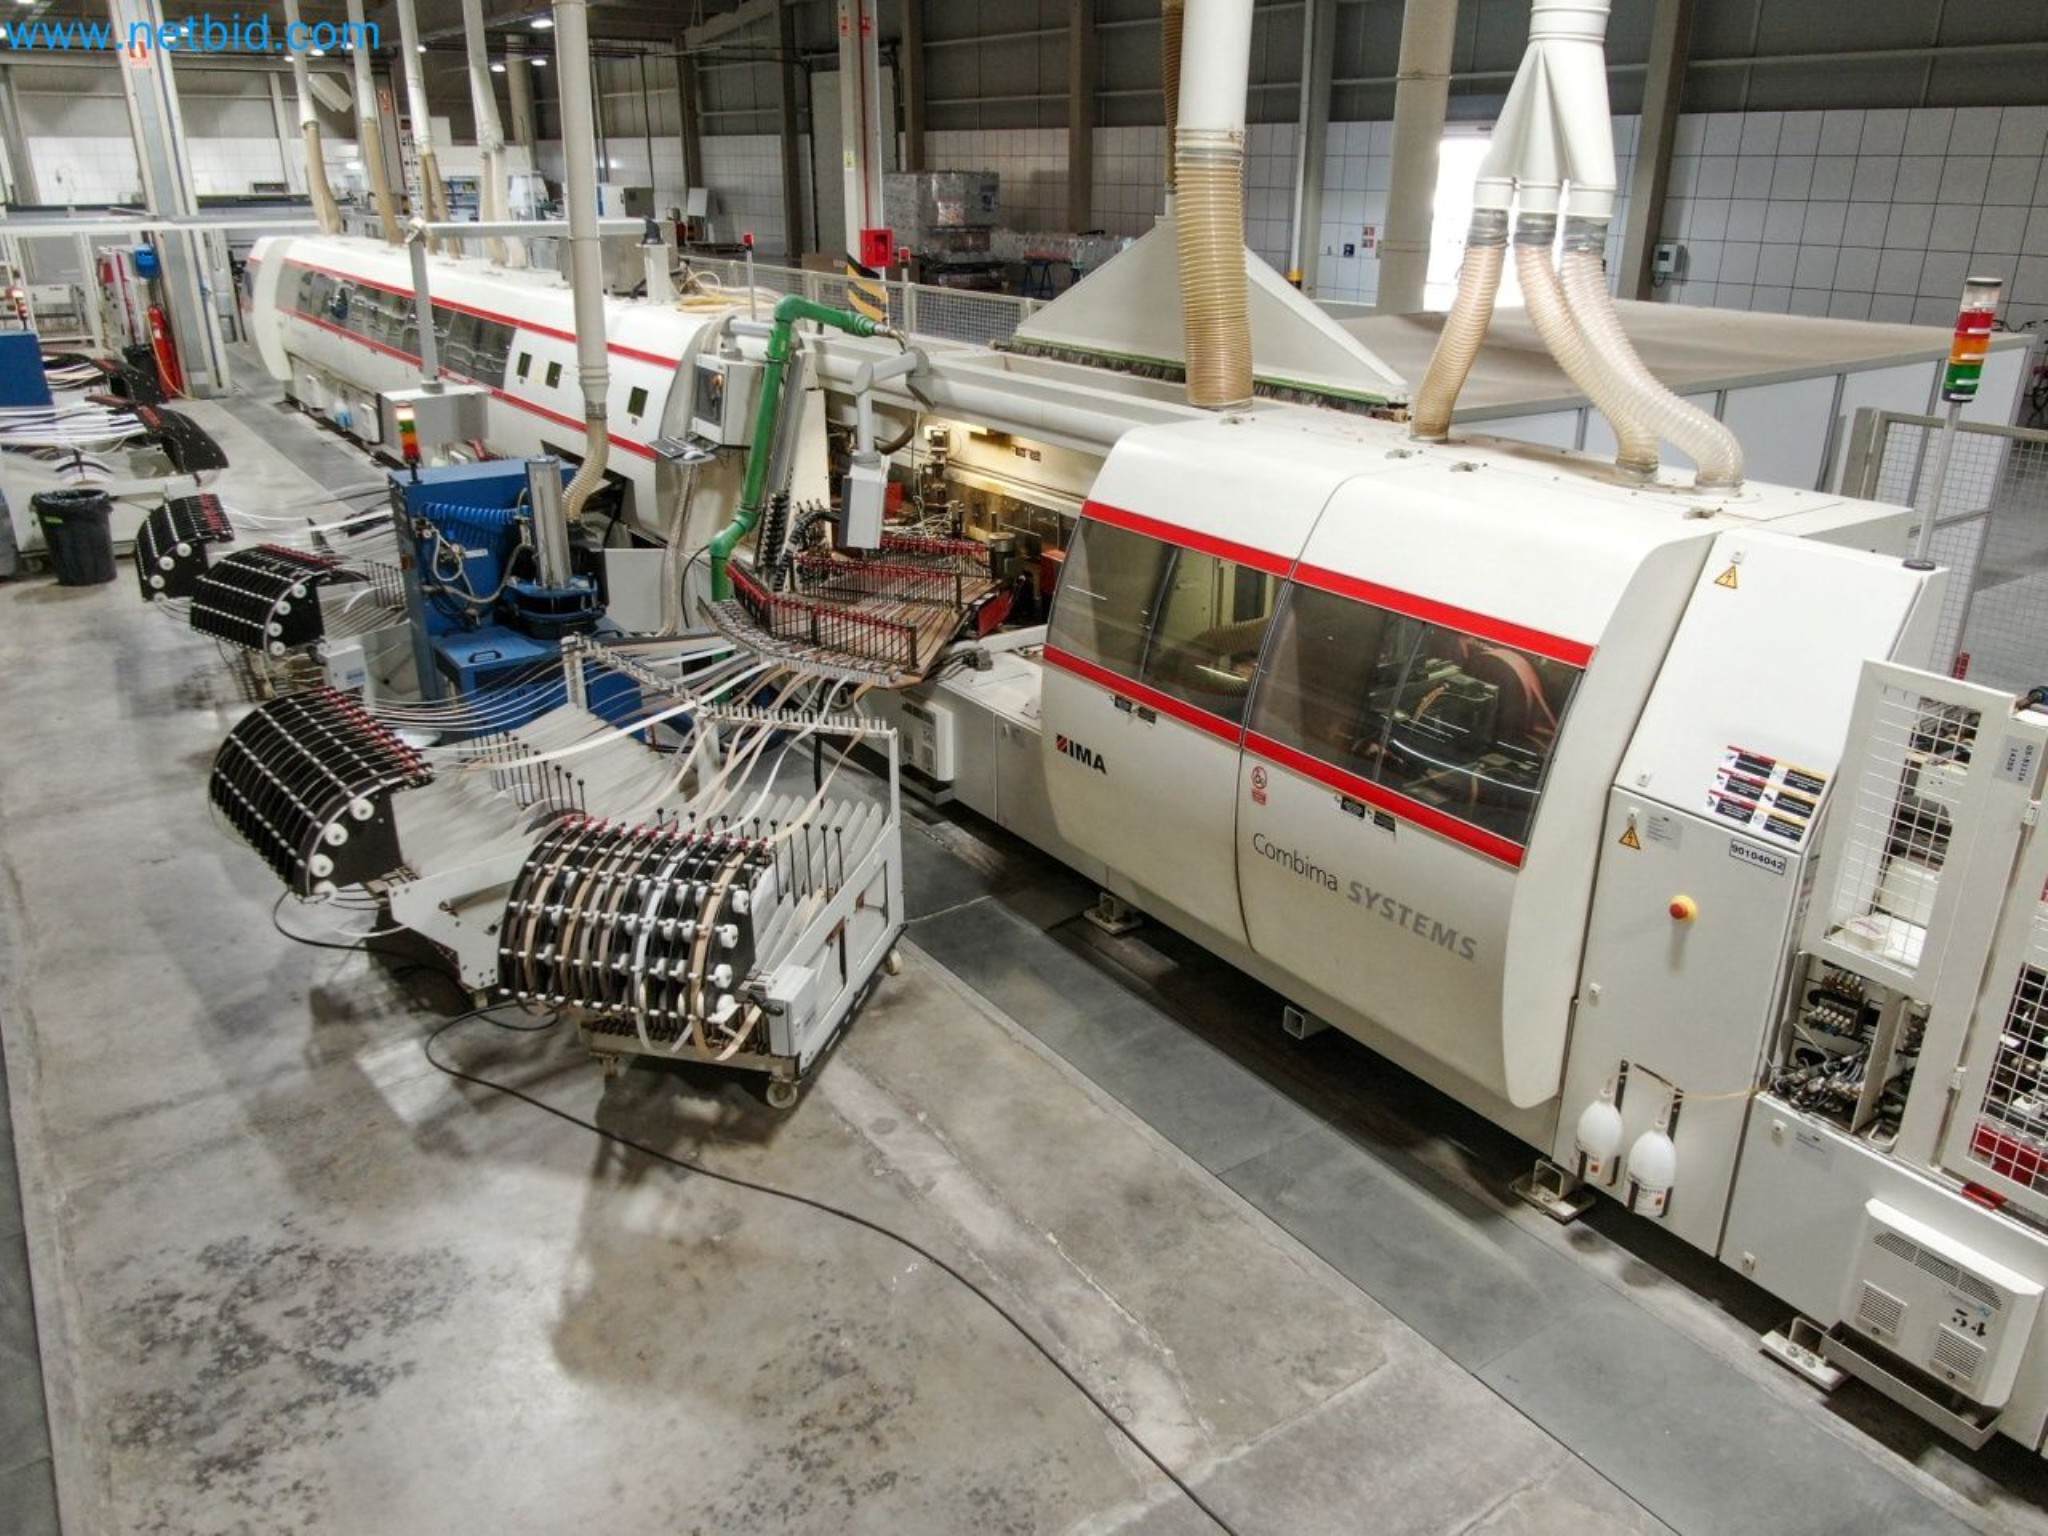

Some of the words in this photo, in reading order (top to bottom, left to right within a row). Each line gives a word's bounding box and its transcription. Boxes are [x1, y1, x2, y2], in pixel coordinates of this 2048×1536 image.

[1068, 740, 1107, 775] IMA
[1731, 844, 1786, 871] 90104042
[1253, 832, 1338, 892] Combima
[1347, 880, 1478, 961] SYSTEMS
